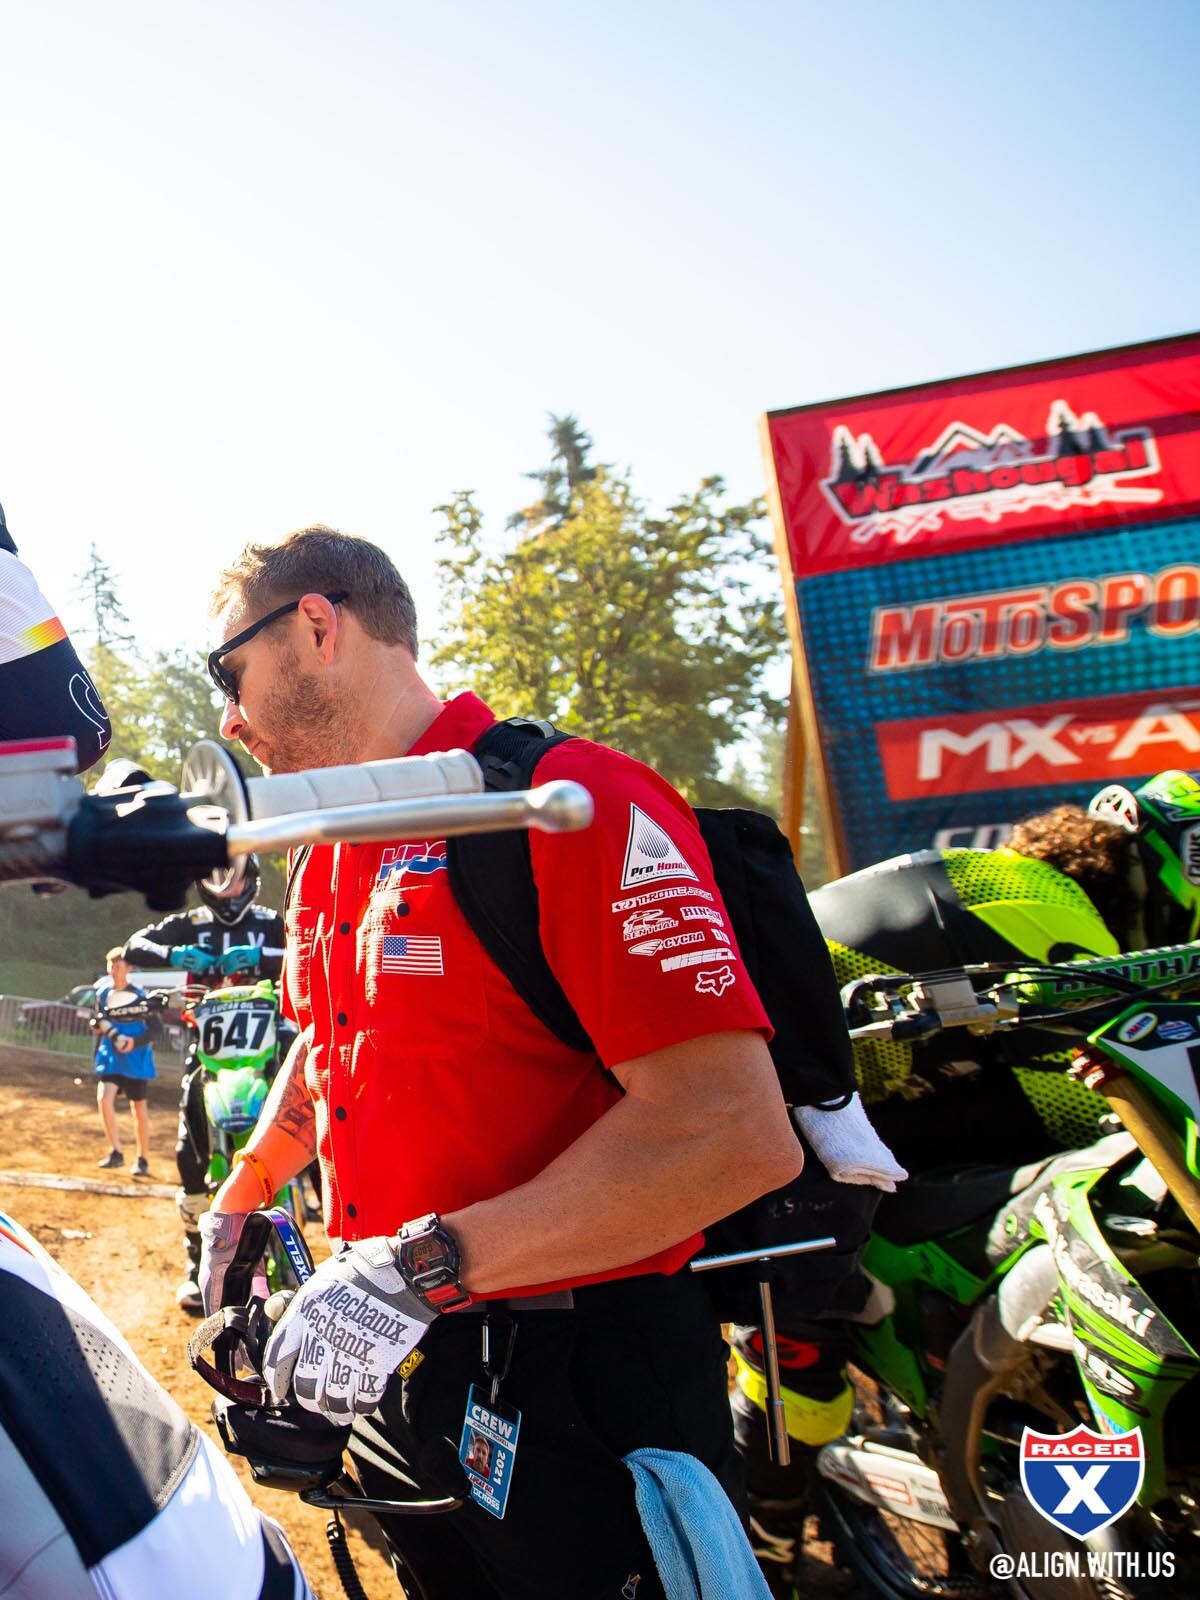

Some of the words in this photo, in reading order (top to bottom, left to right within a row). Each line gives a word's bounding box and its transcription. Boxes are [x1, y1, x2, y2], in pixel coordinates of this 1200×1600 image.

[831, 436, 1151, 519] Washougal
[917, 714, 1083, 781] MX
[1107, 702, 1200, 761] A
[631, 865, 654, 877] Pro
[664, 932, 705, 948] CYCRA
[202, 1011, 272, 1057] 647
[300, 1297, 377, 1361] Mechanix
[319, 1281, 409, 1343] Mechanix
[300, 1333, 380, 1394] Mehaix
[471, 1405, 513, 1439] CREW
[470, 1473, 485, 1488] LUCAS
[492, 1449, 506, 1485] 2021
